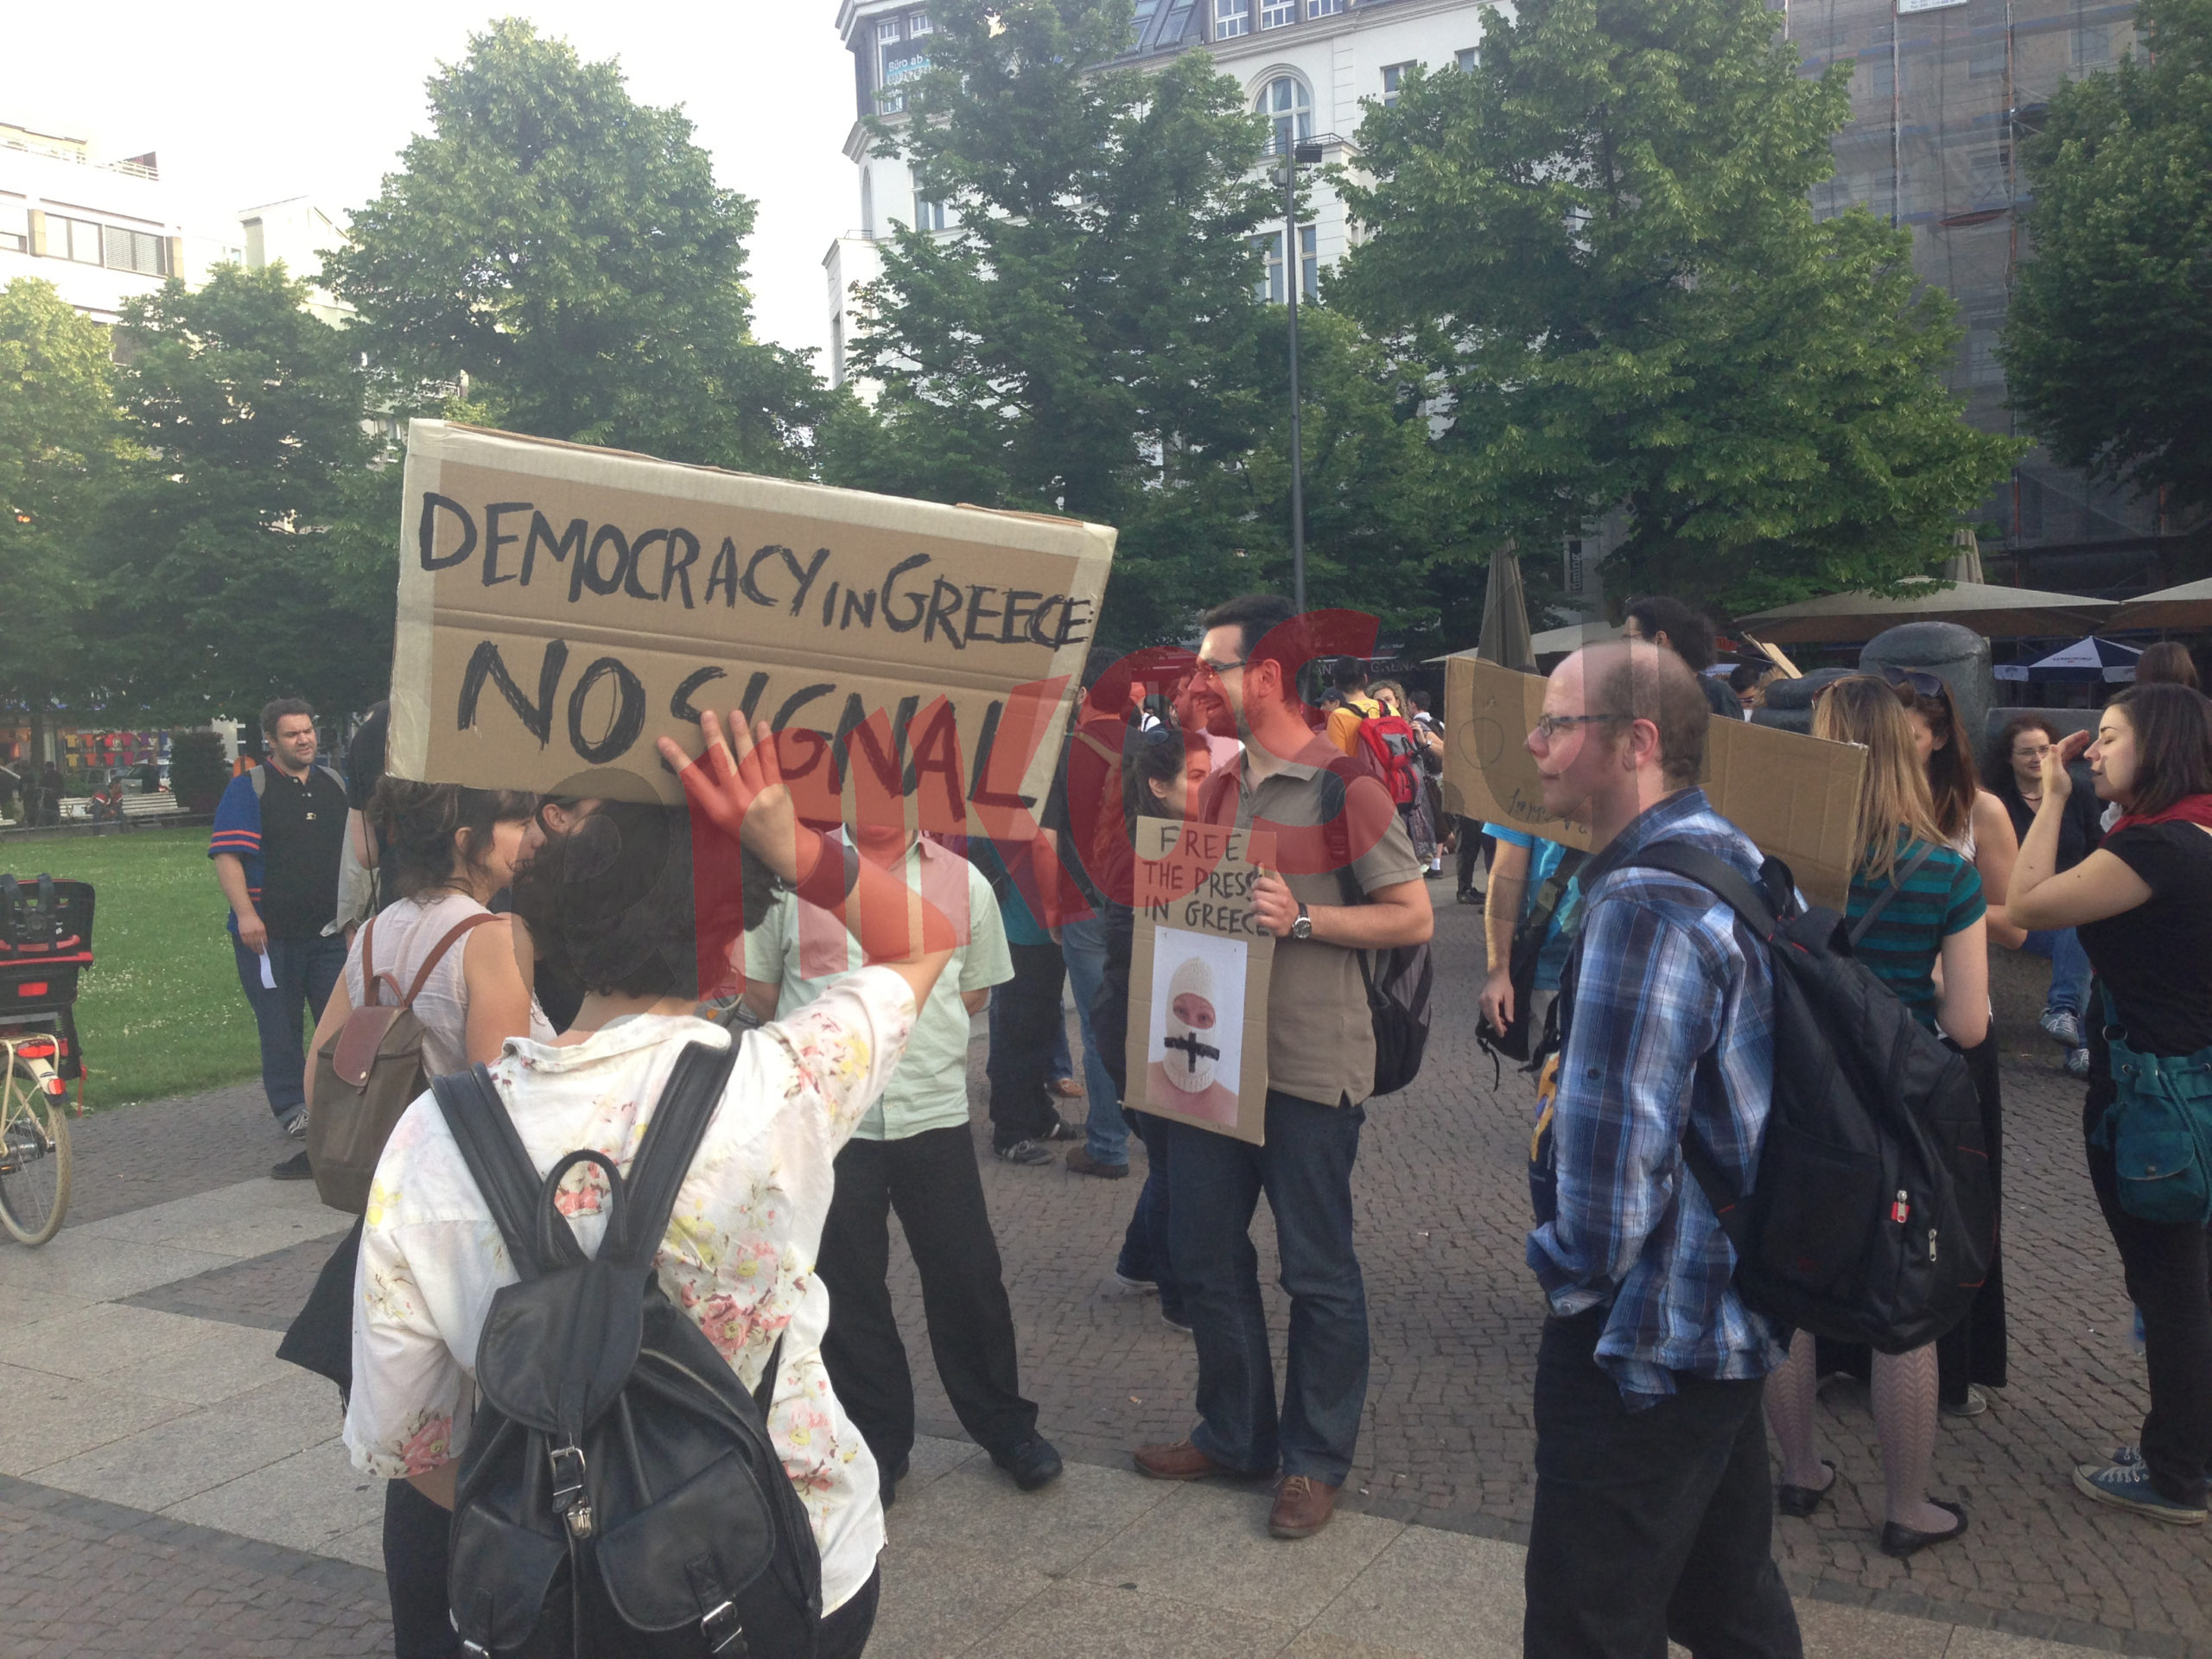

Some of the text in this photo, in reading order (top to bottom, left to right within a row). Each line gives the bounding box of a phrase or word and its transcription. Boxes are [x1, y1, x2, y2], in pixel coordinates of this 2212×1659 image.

[910, 53, 924, 66] ab
[418, 491, 830, 618] DEMOCRACY
[458, 639, 1038, 823] NO SIGNAL
[1160, 825, 1242, 861] FREE
[1142, 861, 1183, 890] THE
[1144, 894, 1169, 922] IN
